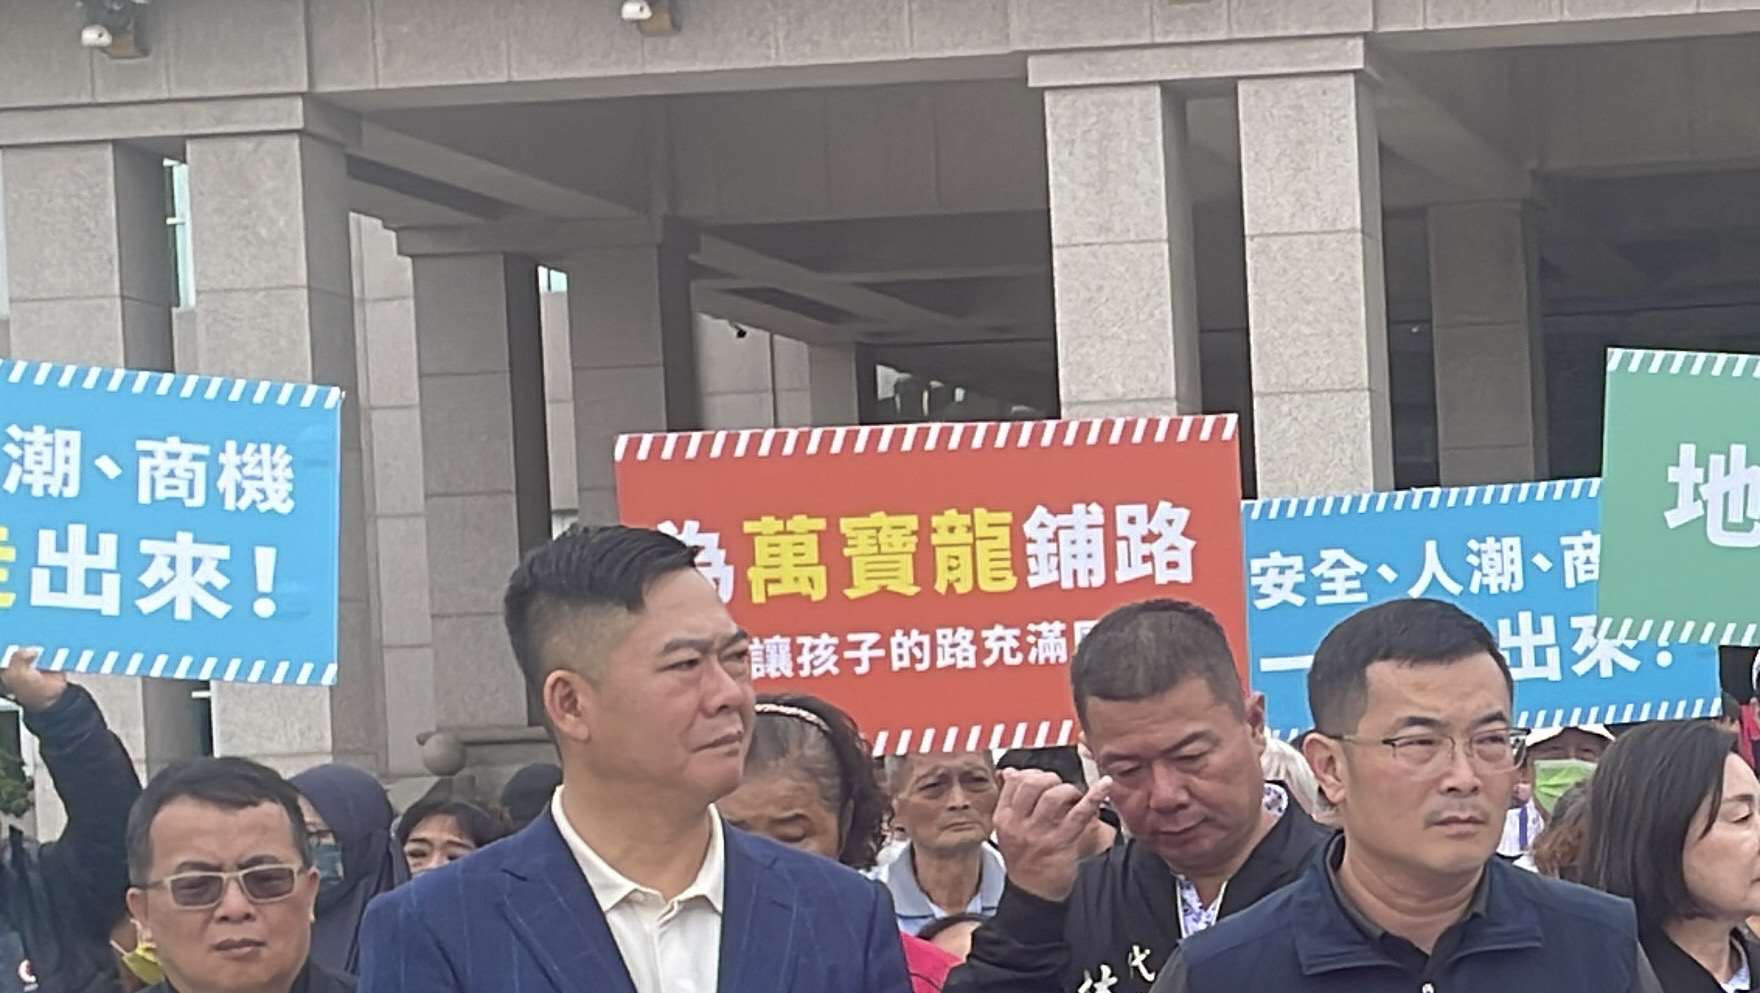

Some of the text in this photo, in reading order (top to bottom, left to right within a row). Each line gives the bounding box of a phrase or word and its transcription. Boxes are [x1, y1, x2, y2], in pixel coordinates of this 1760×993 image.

[2, 423, 296, 515] 潮、商機
[0, 522, 279, 622] 出來!
[1249, 530, 1601, 609] 安全、人潮、商
[748, 618, 1101, 680] 讓孩子的路充滿
